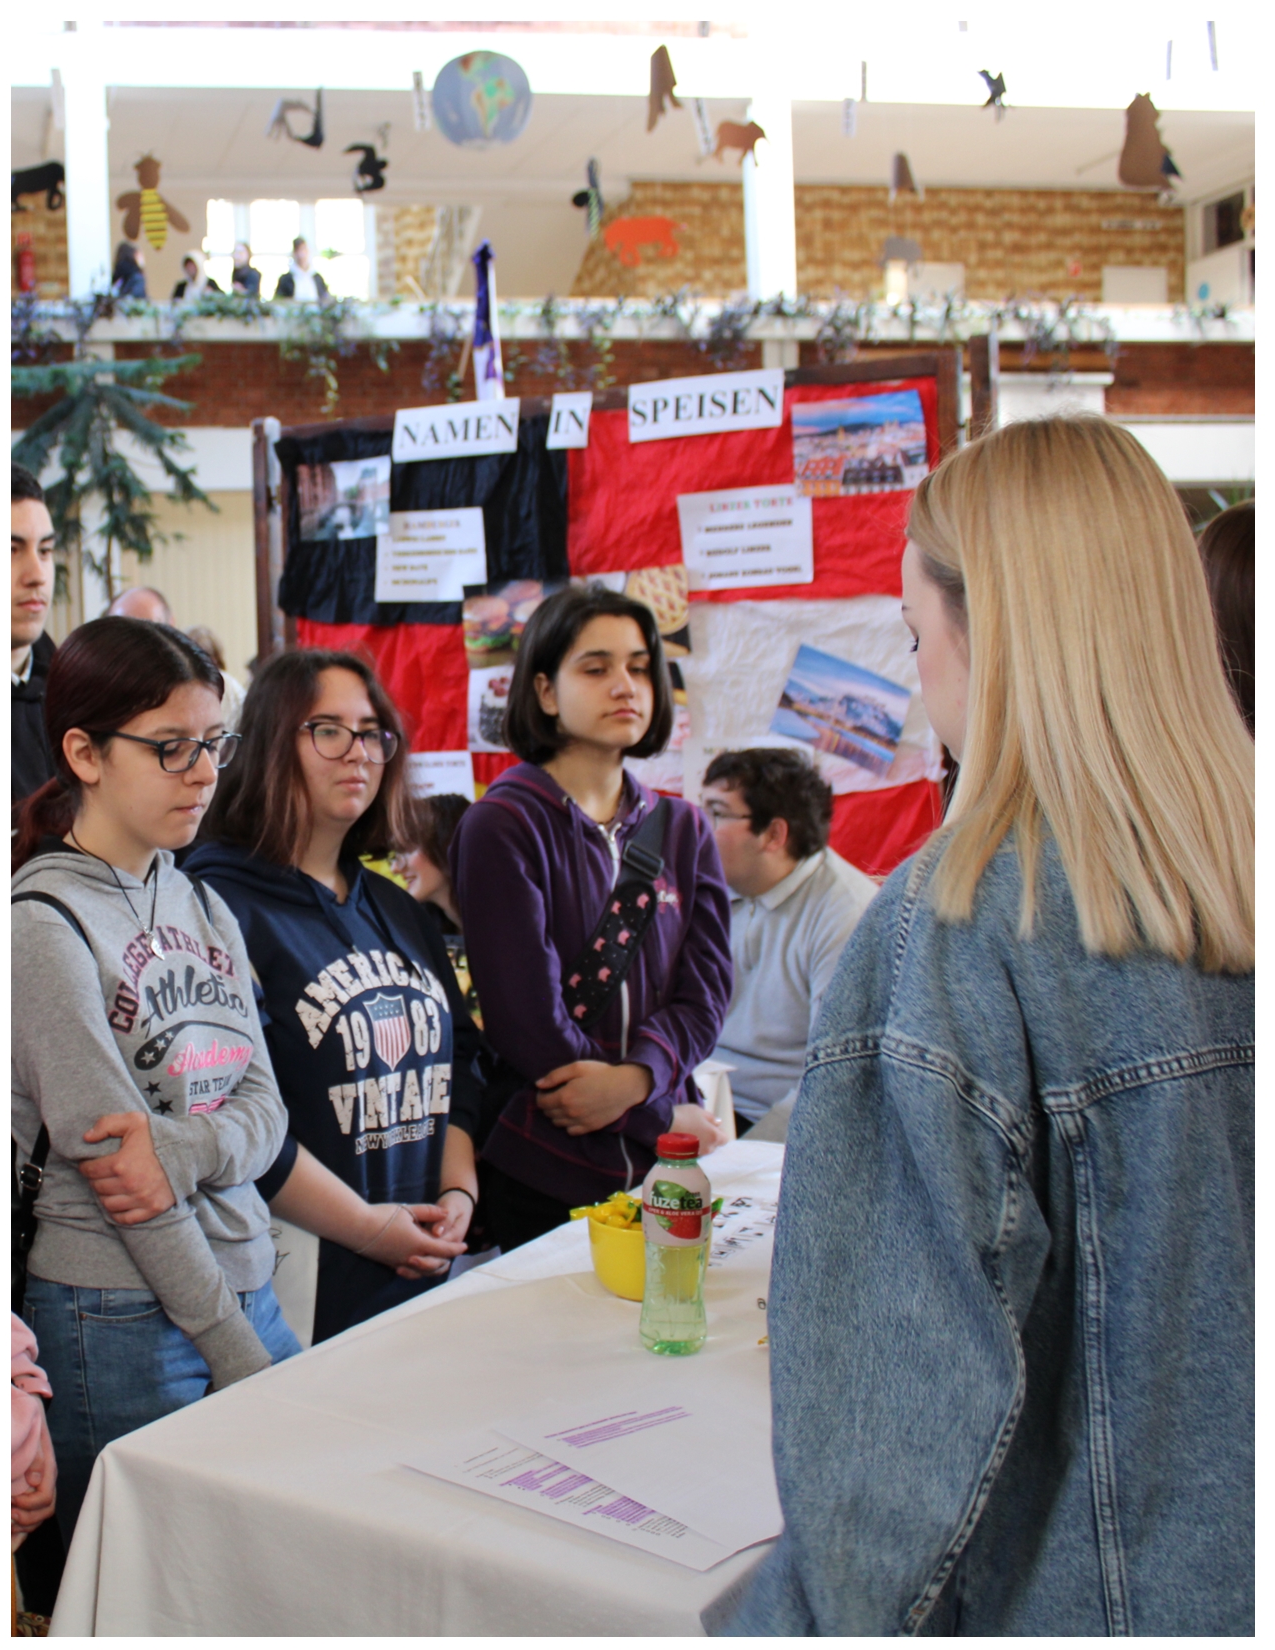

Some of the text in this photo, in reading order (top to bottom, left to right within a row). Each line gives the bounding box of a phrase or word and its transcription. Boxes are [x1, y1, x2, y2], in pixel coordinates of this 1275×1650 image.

[399, 384, 779, 449] NAMEN IN SPEISEN
[141, 964, 248, 1040] Athletic
